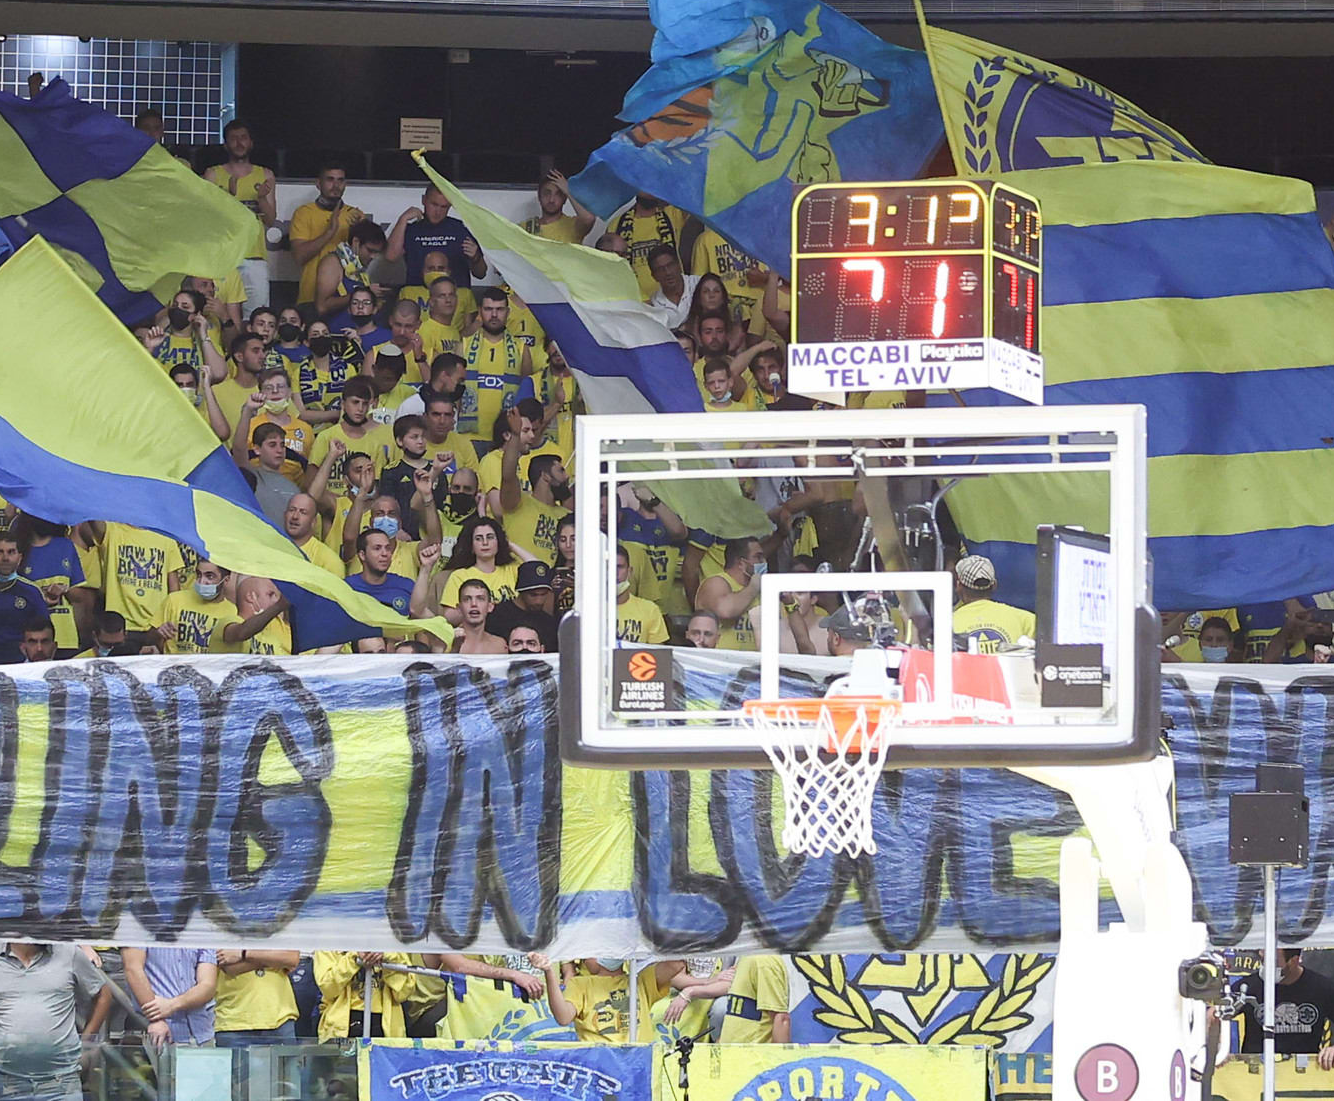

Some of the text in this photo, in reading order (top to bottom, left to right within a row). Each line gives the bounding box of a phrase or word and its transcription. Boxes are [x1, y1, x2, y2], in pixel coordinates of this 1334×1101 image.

[843, 260, 949, 338] 71
[489, 349, 495, 363] 1
[792, 344, 983, 366] MACCABI Playtika
[825, 367, 952, 387] TEL AVIV
[118, 546, 164, 561] NOW I'M
[118, 560, 164, 579] BACK
[179, 609, 208, 624] NOW
[1059, 671, 1102, 680] oneteam
[621, 682, 664, 691] TURKISH
[621, 691, 664, 700] AIRLINES
[619, 700, 665, 710] EuroLeague
[387, 660, 559, 950] IN
[1096, 1059, 1118, 1093] B
[1173, 1065, 1182, 1086] B
